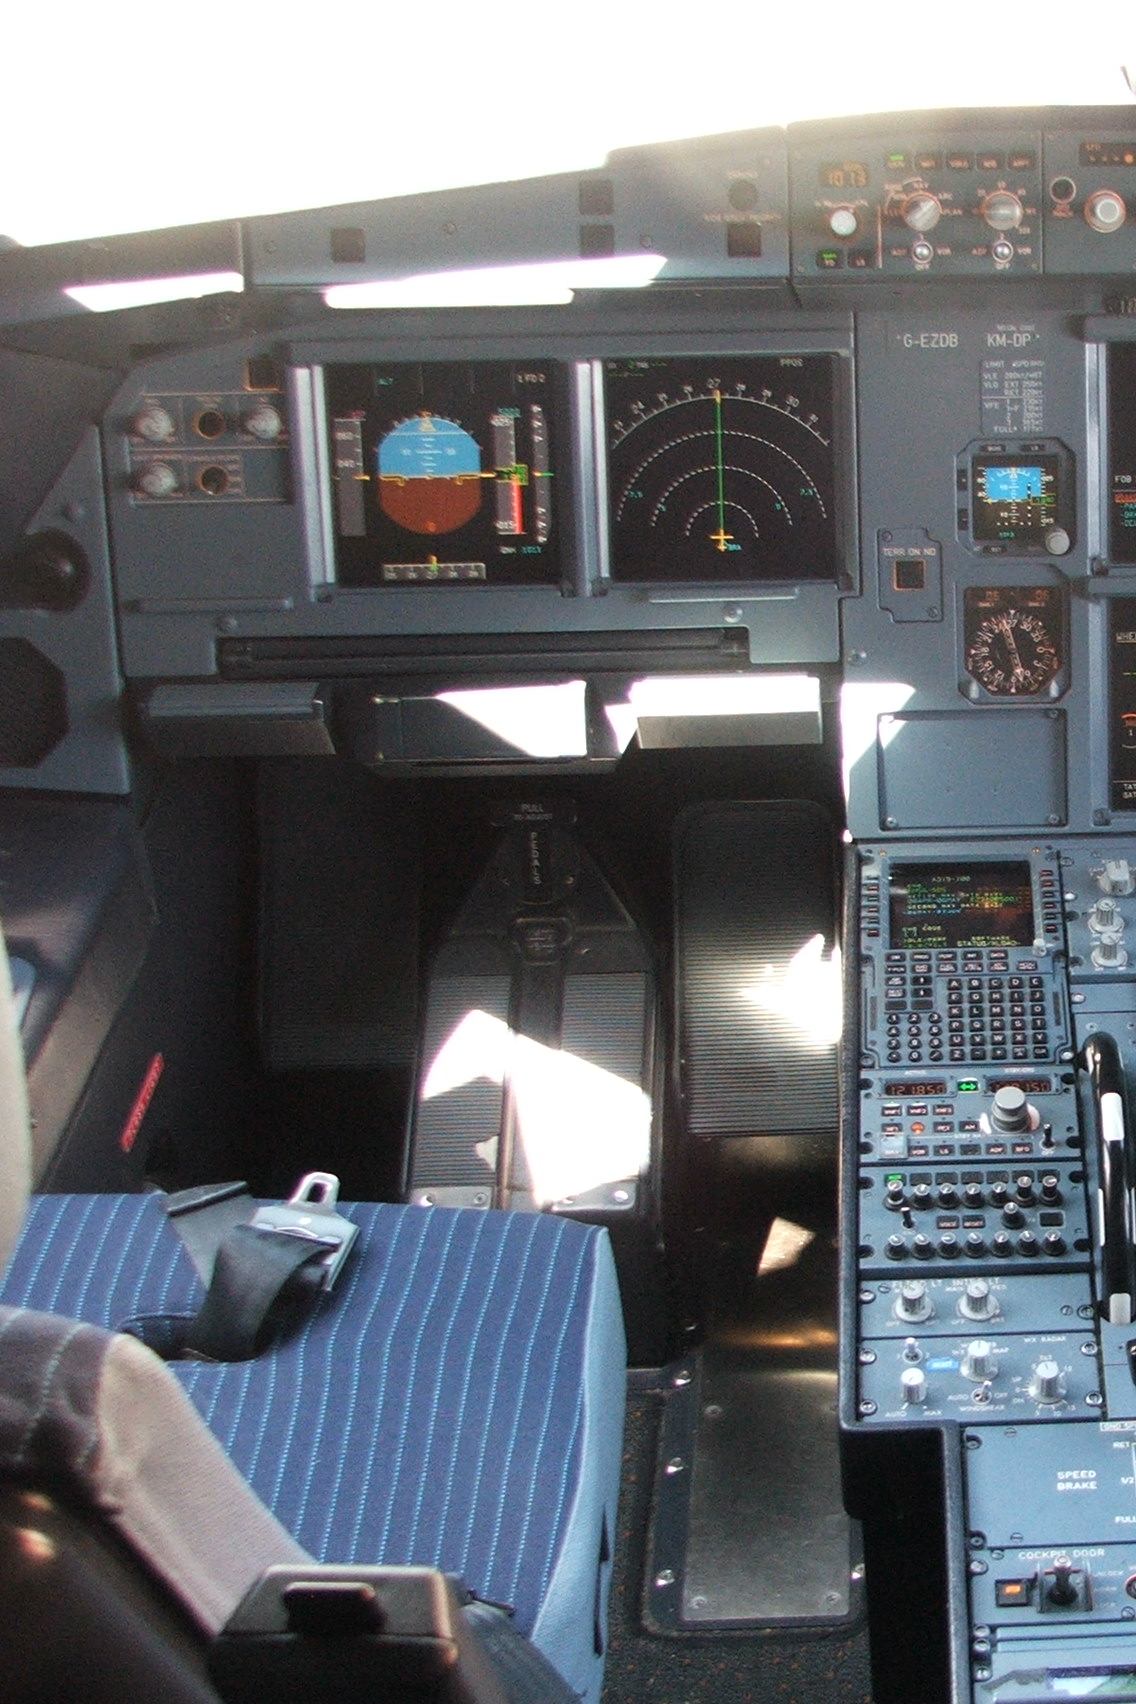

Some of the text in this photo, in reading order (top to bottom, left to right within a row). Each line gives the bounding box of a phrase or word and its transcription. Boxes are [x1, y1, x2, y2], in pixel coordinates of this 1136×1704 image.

[903, 332, 959, 349] G-EZDB
[986, 332, 1032, 348] KM-DP
[1056, 1470, 1097, 1480] SPEED
[1056, 1481, 1098, 1492] BRAKE
[1073, 1548, 1106, 1558] DOOR
